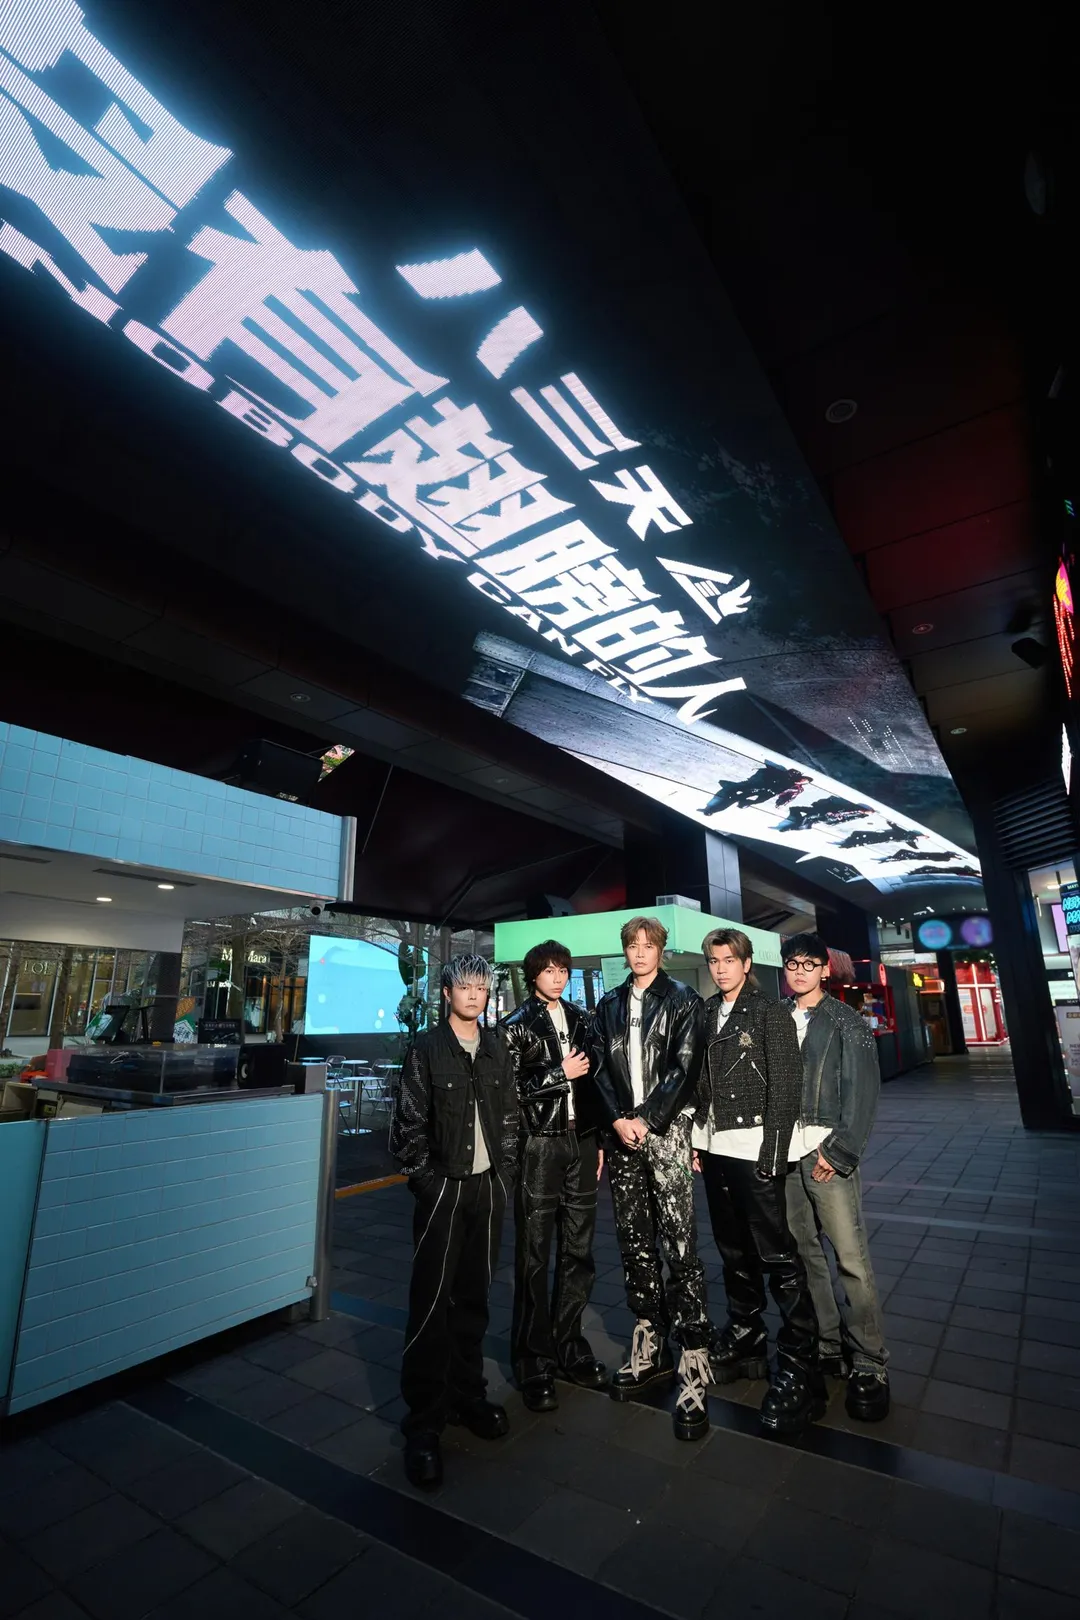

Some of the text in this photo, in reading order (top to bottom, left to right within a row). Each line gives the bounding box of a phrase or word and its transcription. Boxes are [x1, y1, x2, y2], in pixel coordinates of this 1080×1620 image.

[0, 218, 654, 703] NOBODY CAN FLY
